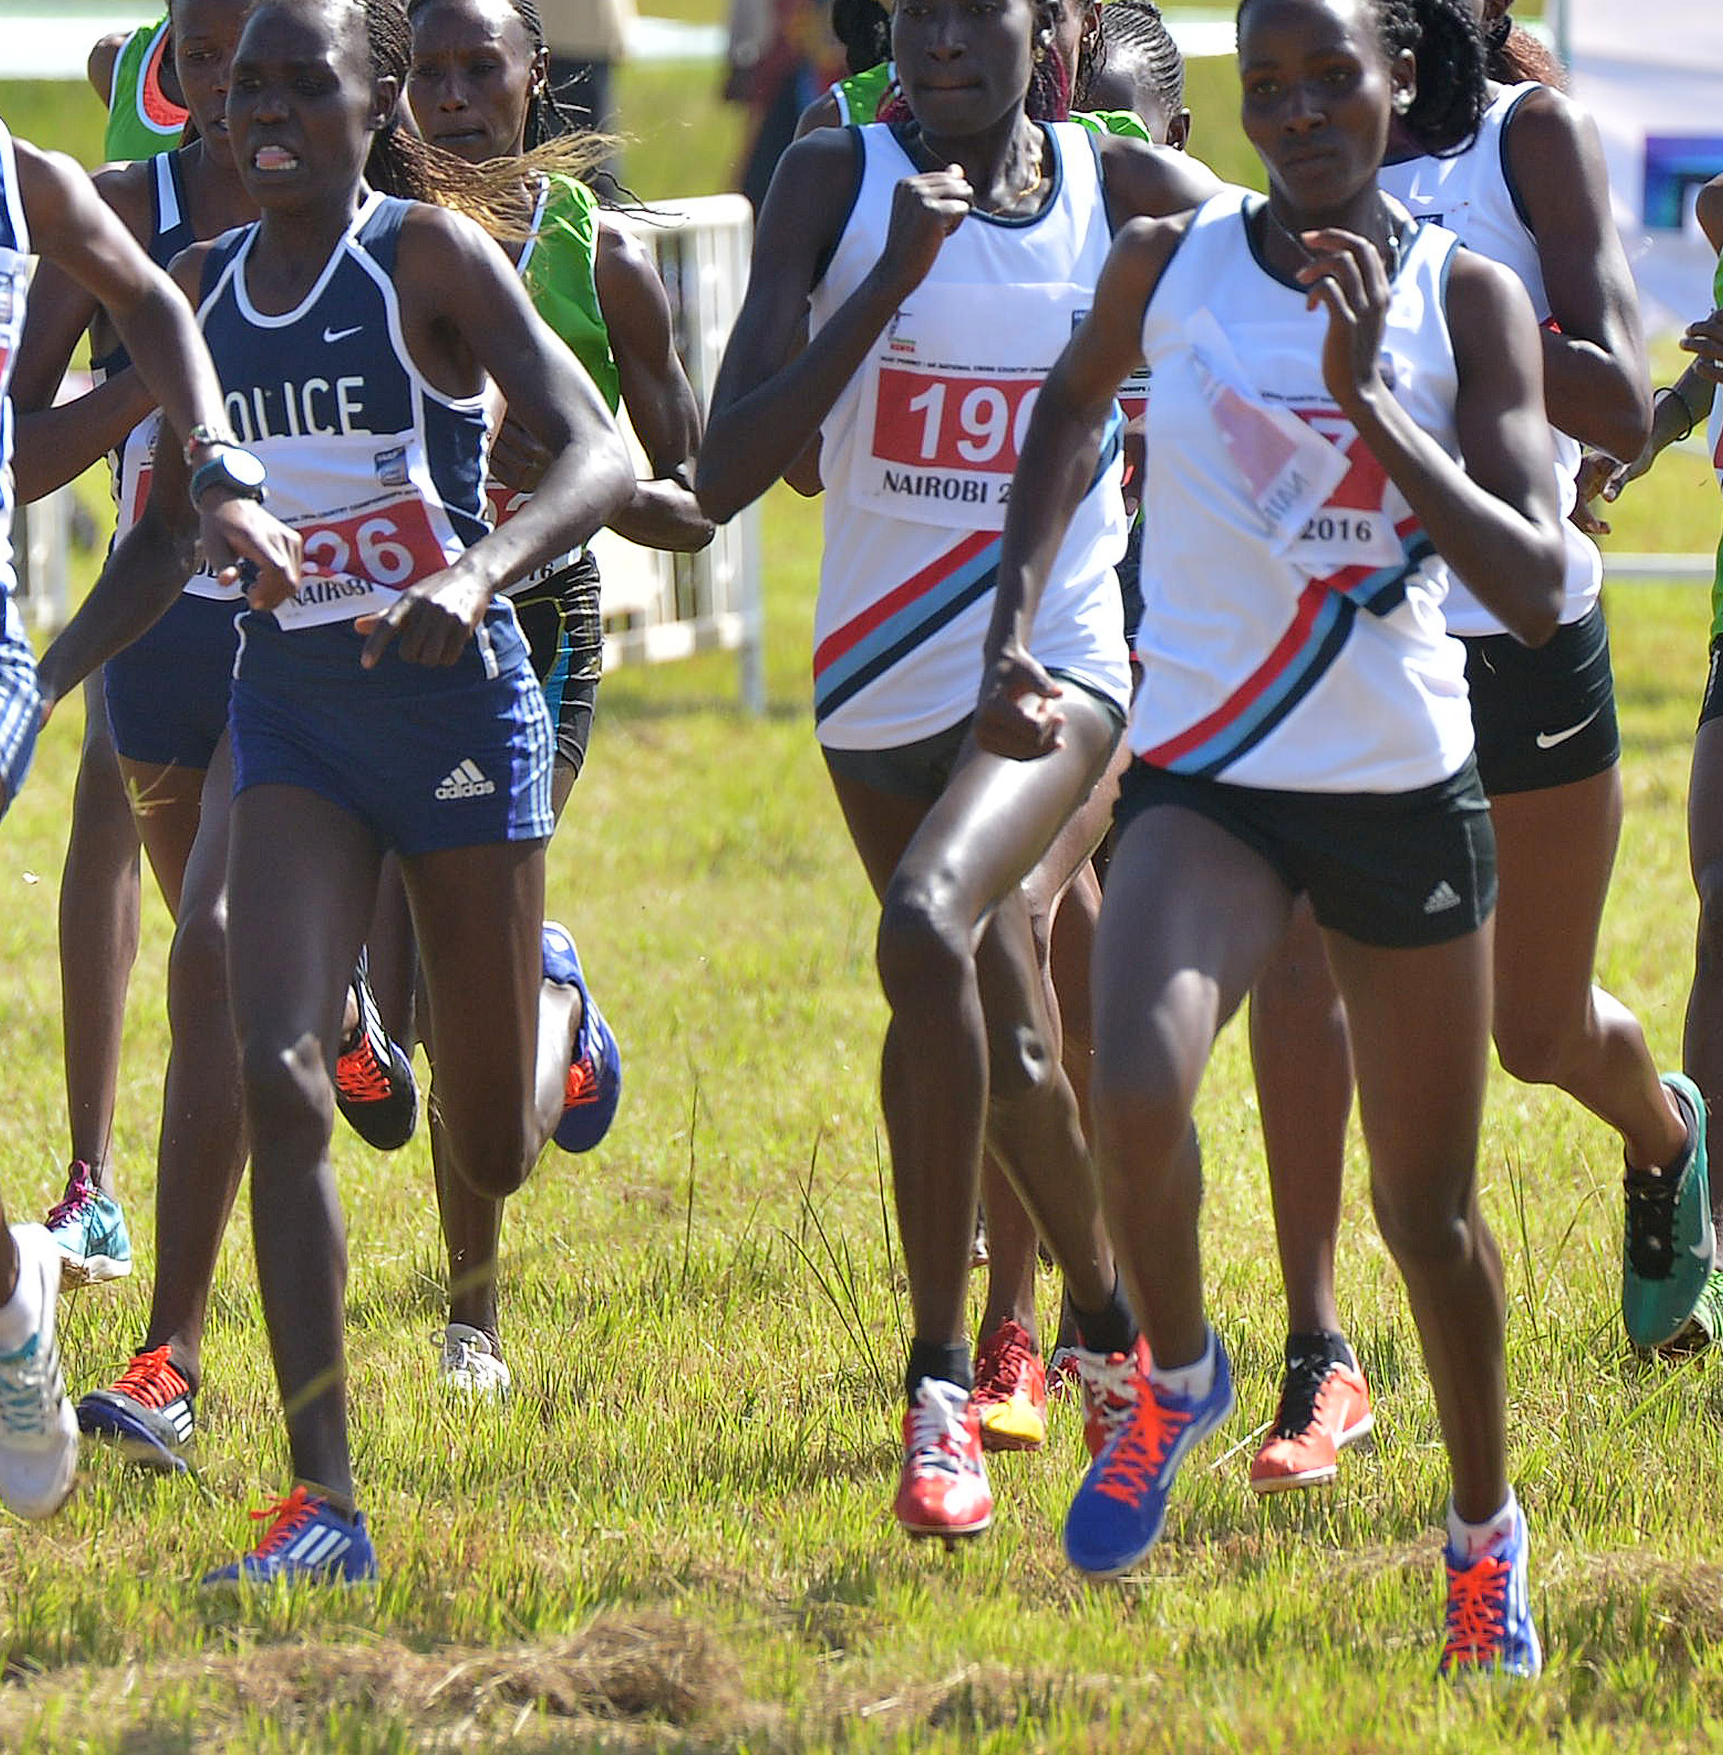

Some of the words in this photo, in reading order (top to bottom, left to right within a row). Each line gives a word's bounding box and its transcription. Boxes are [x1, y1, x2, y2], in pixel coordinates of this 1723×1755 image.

[225, 375, 371, 444] OLICE
[882, 469, 988, 504] NAIROBI
[1299, 517, 1373, 543] 2016
[303, 517, 415, 584] 26
[435, 780, 495, 800] adidas
